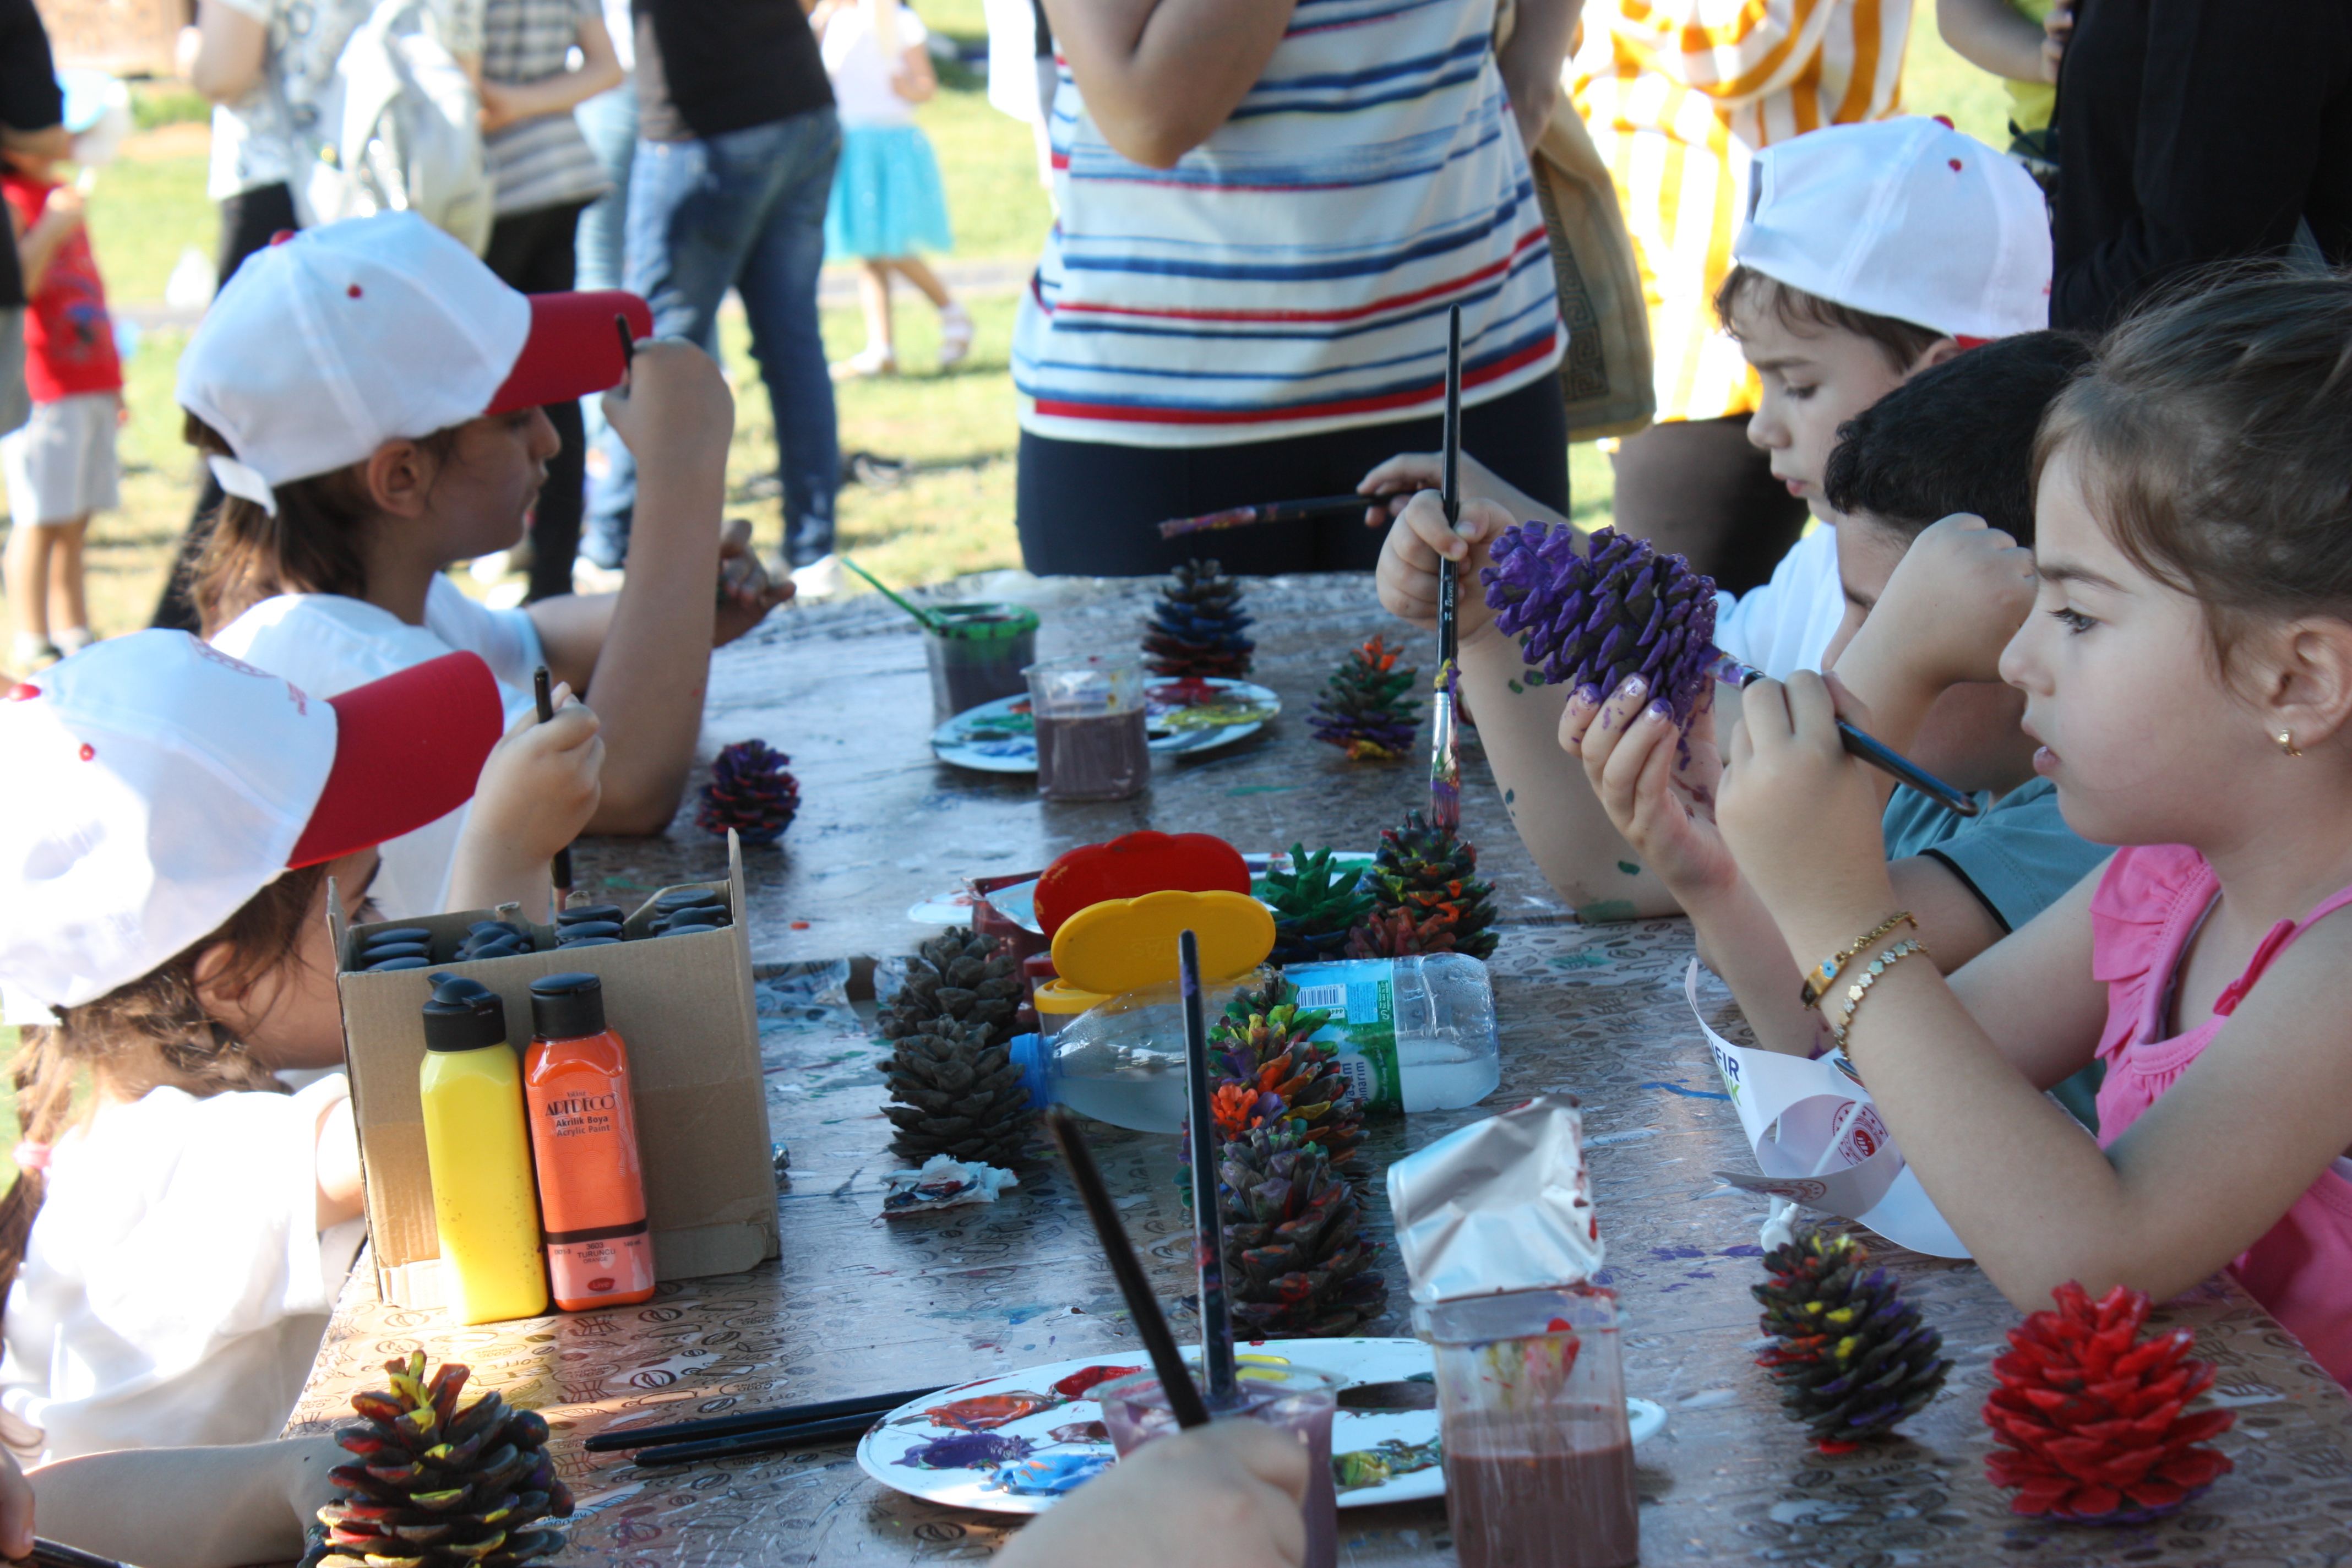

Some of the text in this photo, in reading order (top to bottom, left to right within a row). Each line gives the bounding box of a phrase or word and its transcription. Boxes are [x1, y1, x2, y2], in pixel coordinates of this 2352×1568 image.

[545, 1095, 616, 1117] ARTDECO
[556, 1115, 608, 1127] Akrilik Boya
[557, 1124, 611, 1137] Acrylic Paint
[577, 1249, 616, 1259] TURUNCU
[591, 1281, 611, 1289] Live
